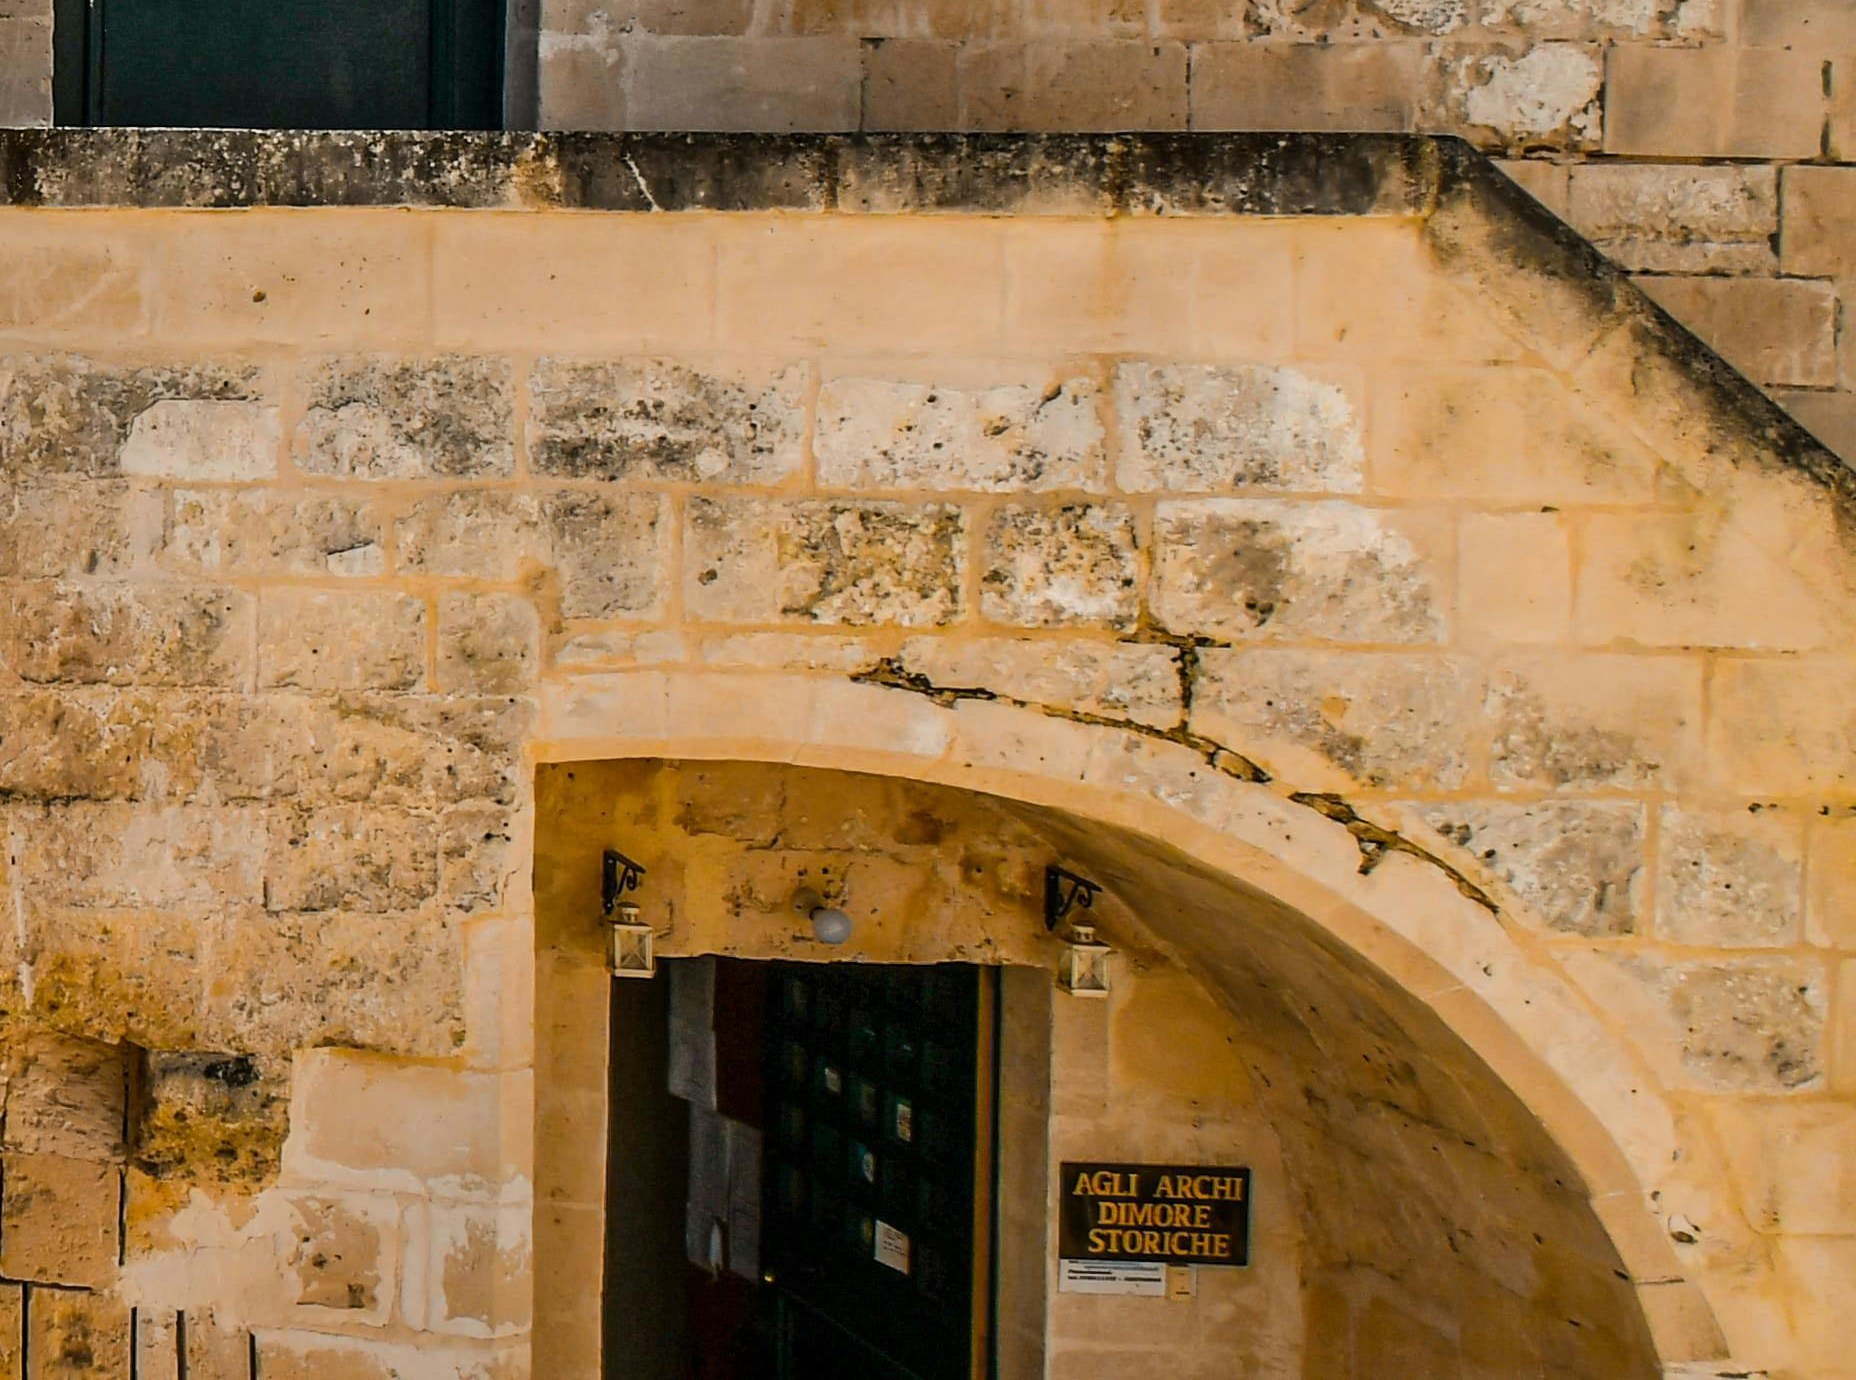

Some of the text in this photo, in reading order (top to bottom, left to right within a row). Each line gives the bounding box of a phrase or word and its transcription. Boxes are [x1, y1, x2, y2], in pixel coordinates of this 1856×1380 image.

[1072, 1171, 1243, 1201] AGLI ARCHI
[1098, 1201, 1211, 1228] DIMORE
[1088, 1229, 1231, 1257] STORICHE
